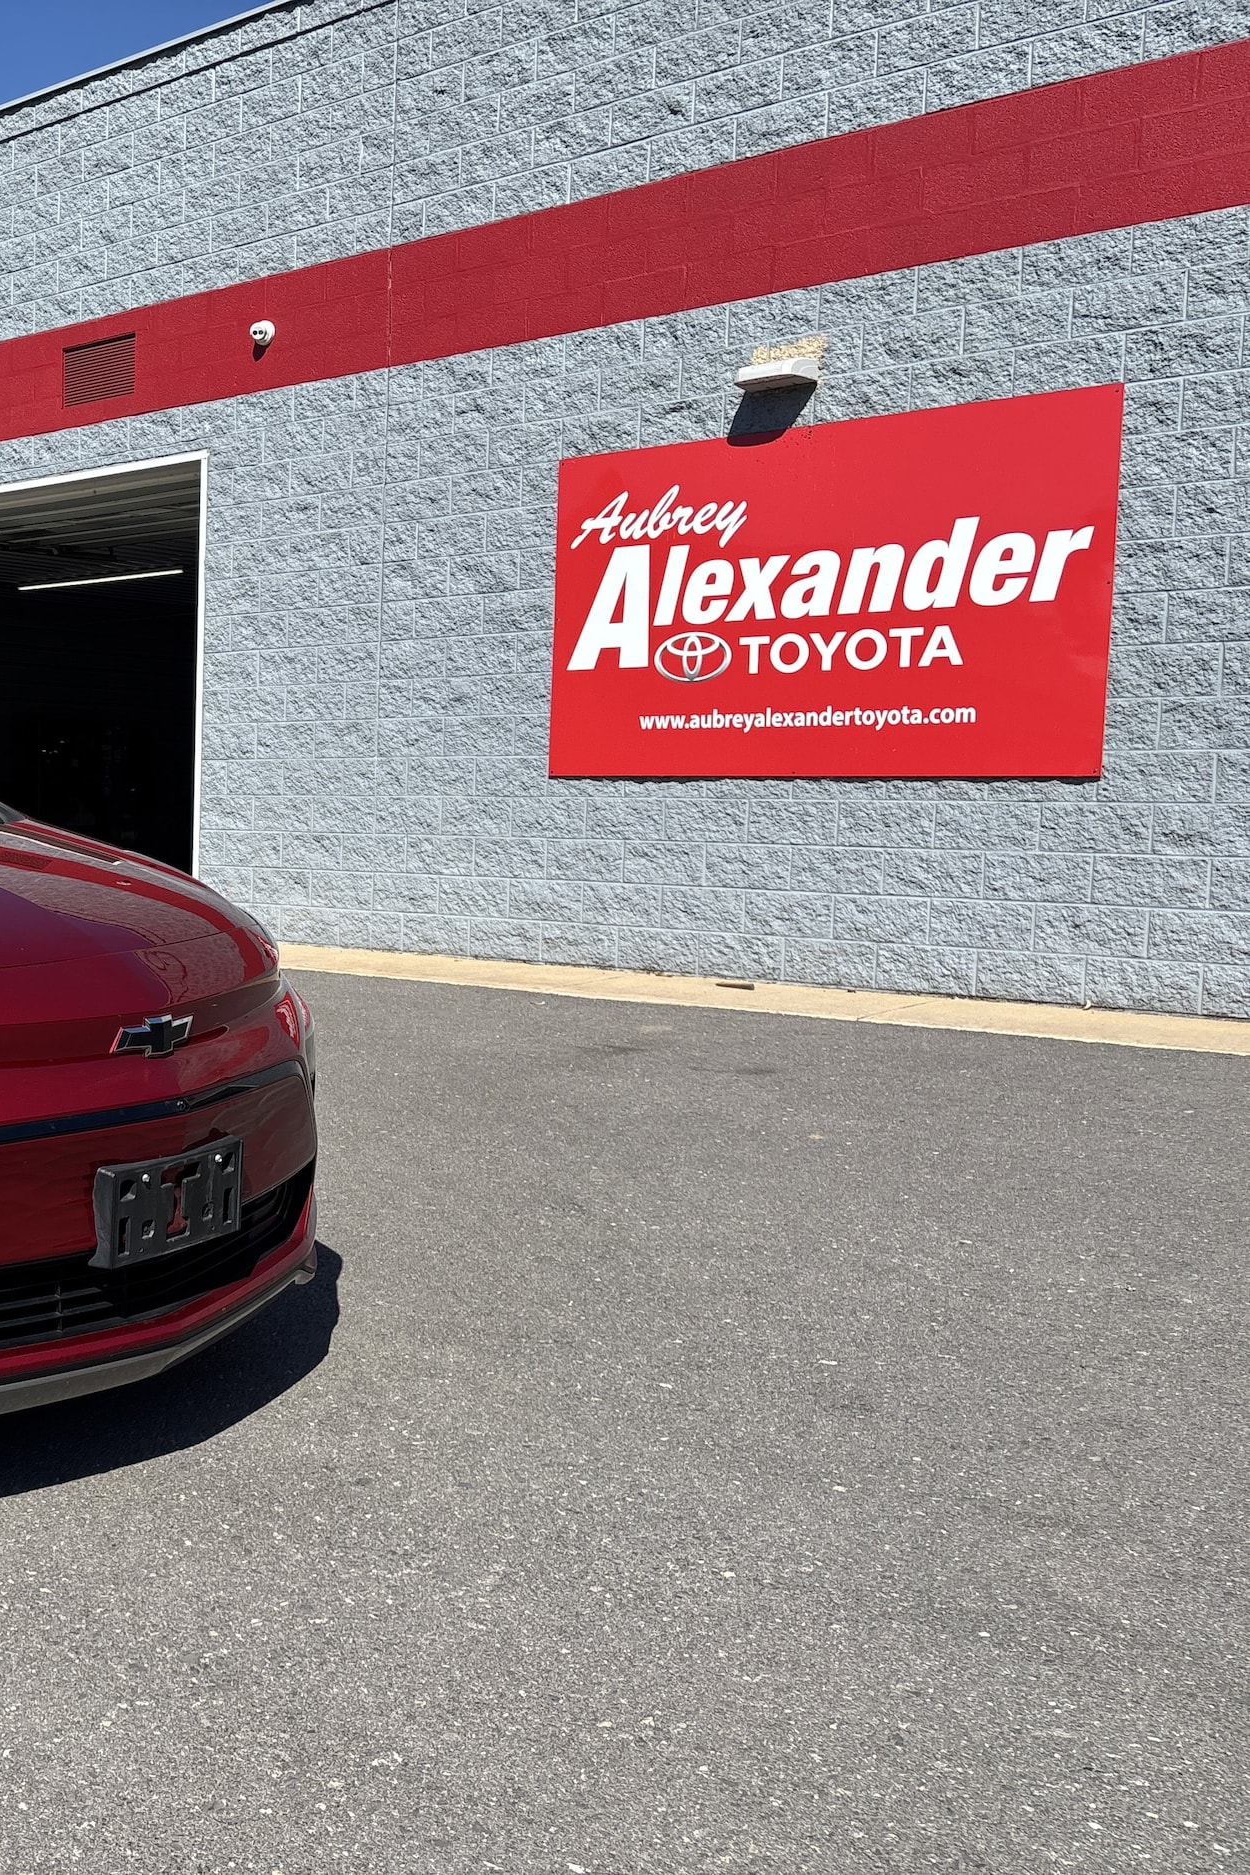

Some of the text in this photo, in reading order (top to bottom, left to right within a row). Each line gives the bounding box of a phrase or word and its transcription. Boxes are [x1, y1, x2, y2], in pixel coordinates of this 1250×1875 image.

[570, 484, 748, 550] Aubrey
[567, 516, 1095, 671] Alexander
[739, 625, 964, 675] TOYOTA
[639, 704, 977, 733] www.aubreyalexandertoyota.com
